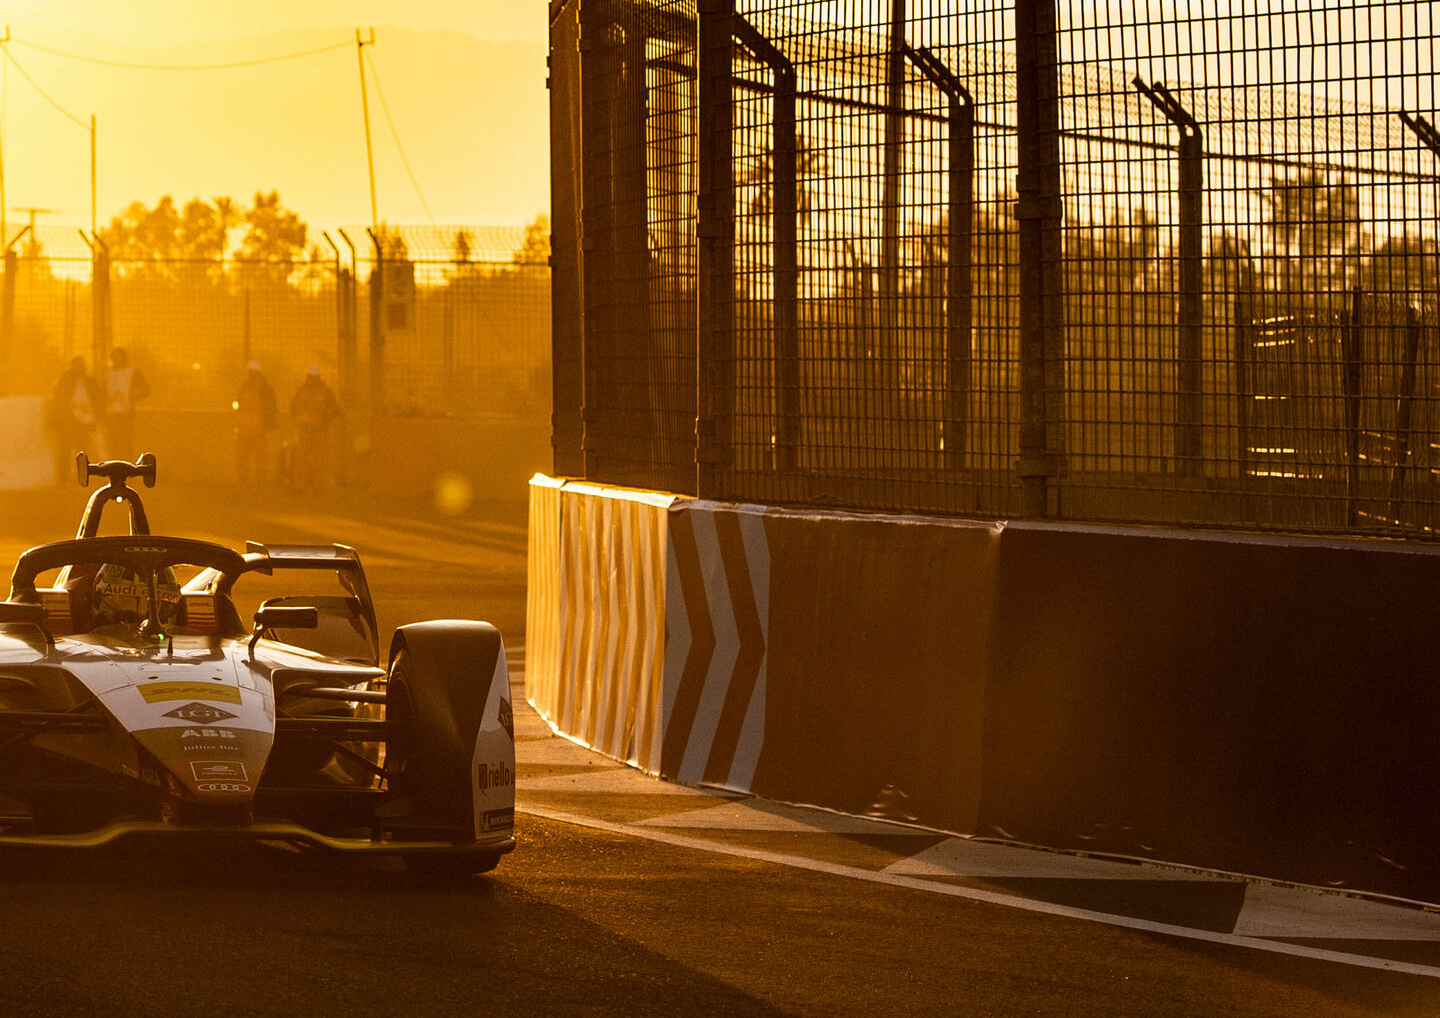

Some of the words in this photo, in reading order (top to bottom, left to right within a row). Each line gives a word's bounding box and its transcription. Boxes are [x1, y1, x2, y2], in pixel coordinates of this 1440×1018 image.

[104, 583, 137, 595] Audi
[177, 709, 226, 719] LGT
[181, 728, 236, 739] ABB
[487, 761, 509, 789] riello
